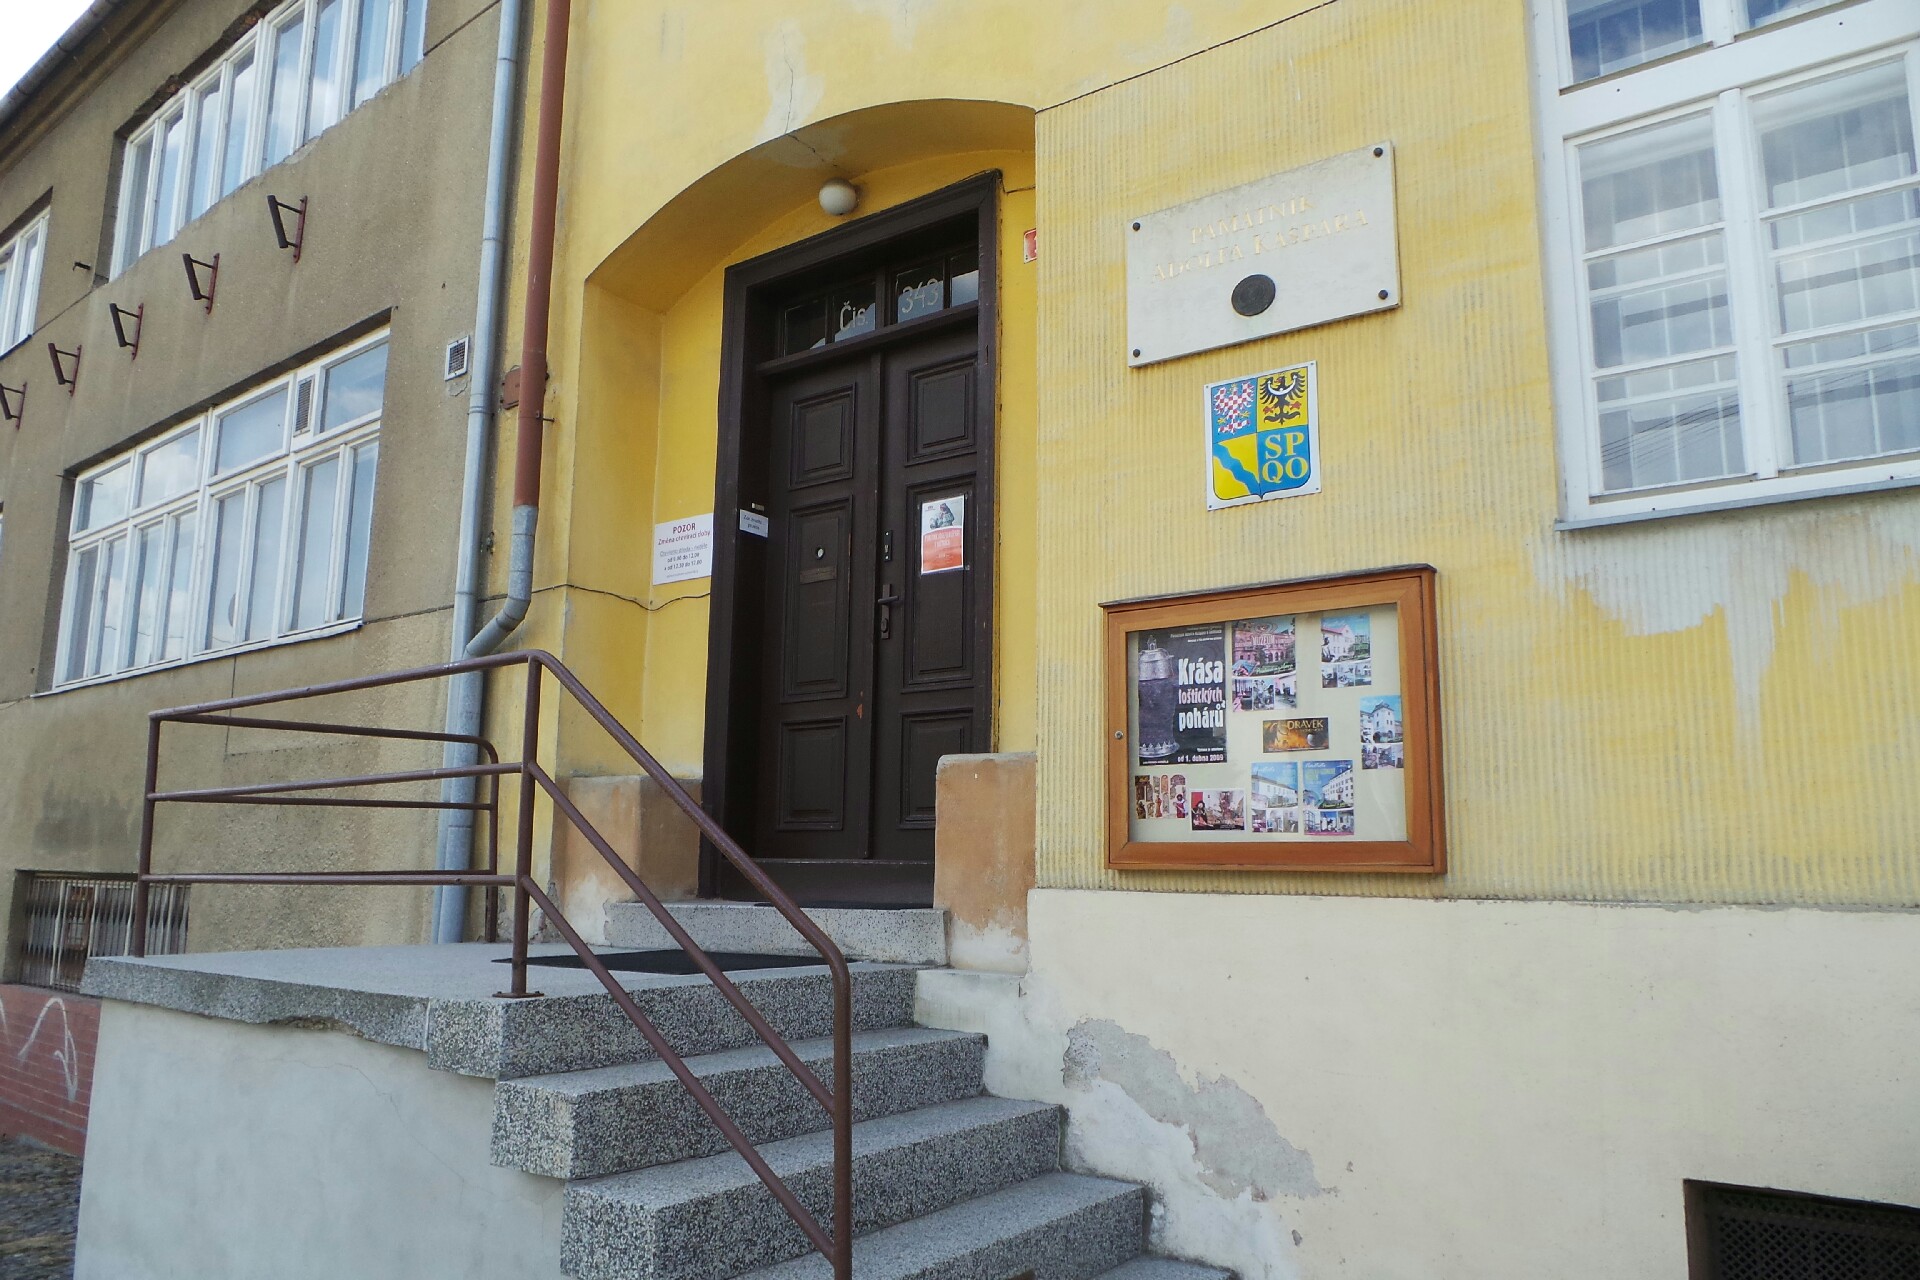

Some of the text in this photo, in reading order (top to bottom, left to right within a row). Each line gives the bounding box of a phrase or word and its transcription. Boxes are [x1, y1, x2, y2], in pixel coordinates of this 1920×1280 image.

[1151, 244, 1244, 283] ADOLFA
[901, 278, 938, 313] 343
[1265, 432, 1304, 459] SP
[1262, 456, 1309, 483] QO
[672, 522, 696, 534] POZOR
[1178, 657, 1223, 685] Krása
[1178, 687, 1223, 704] loštických
[1178, 703, 1224, 732] pohárů
[1192, 754, 1209, 762] dubna
[1209, 754, 1224, 762] 2009
